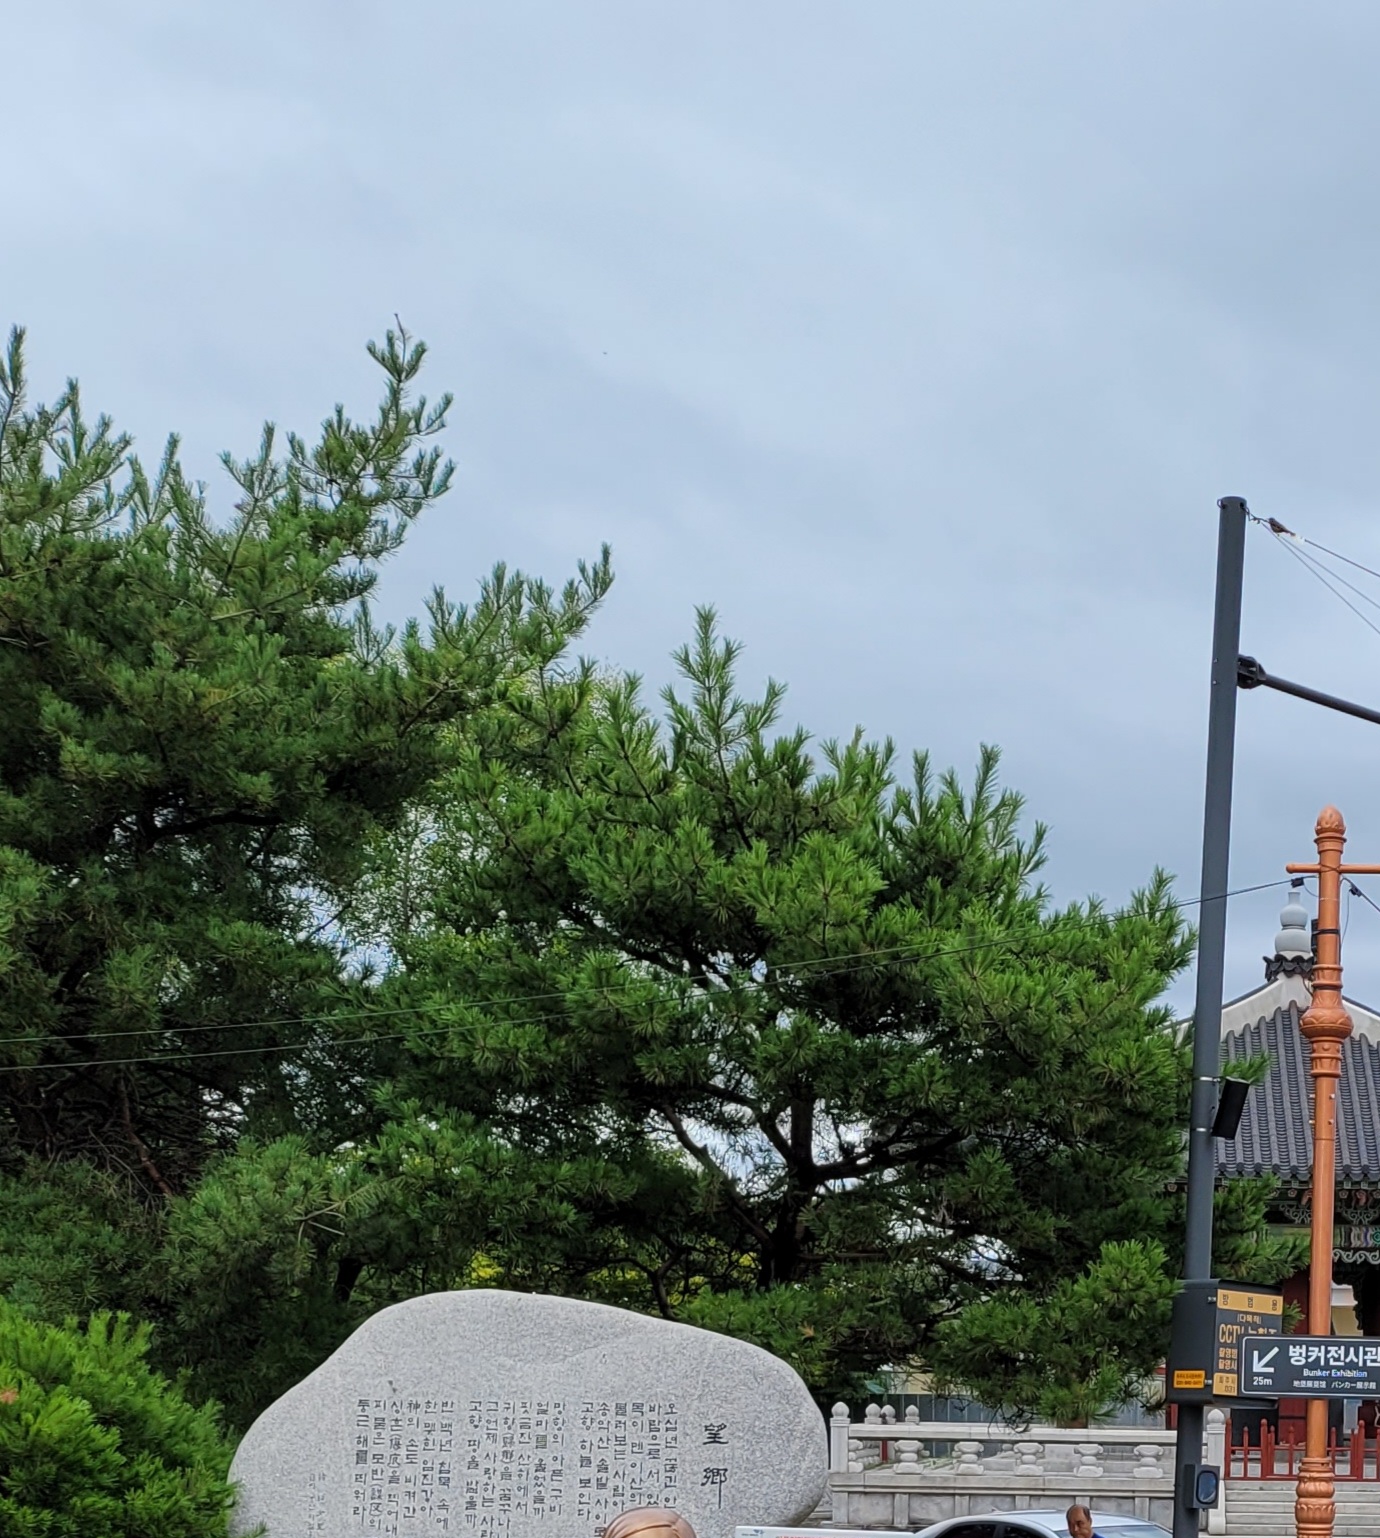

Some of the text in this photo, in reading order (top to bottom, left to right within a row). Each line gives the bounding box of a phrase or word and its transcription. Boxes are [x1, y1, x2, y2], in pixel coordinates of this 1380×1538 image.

[1252, 1376, 1273, 1386] 25m
[1303, 1368, 1368, 1378] Bunker Exhibition
[356, 1399, 370, 1428] 둥근
[425, 1400, 438, 1414] 한
[551, 1402, 566, 1447] 망향의
[597, 1402, 611, 1450] 송악산
[631, 1402, 644, 1433] 목이
[664, 1403, 678, 1449] 오십년
[355, 1434, 368, 1466] 해를
[405, 1438, 419, 1465] 손도
[647, 1403, 661, 1460] 바람으로
[438, 1461, 451, 1490] 침묵
[464, 1401, 482, 1529] 고향 땅을 밟을까
[481, 1452, 497, 1508] 사랑하는
[532, 1401, 549, 1520] 얼마를 울었을까
[577, 1402, 594, 1521] 고향 하늘 보인다
[403, 1474, 417, 1519] 비켜간
[420, 1459, 435, 1518] 임진강아
[515, 1453, 532, 1515] 산하에서
[436, 1498, 450, 1531] 속에
